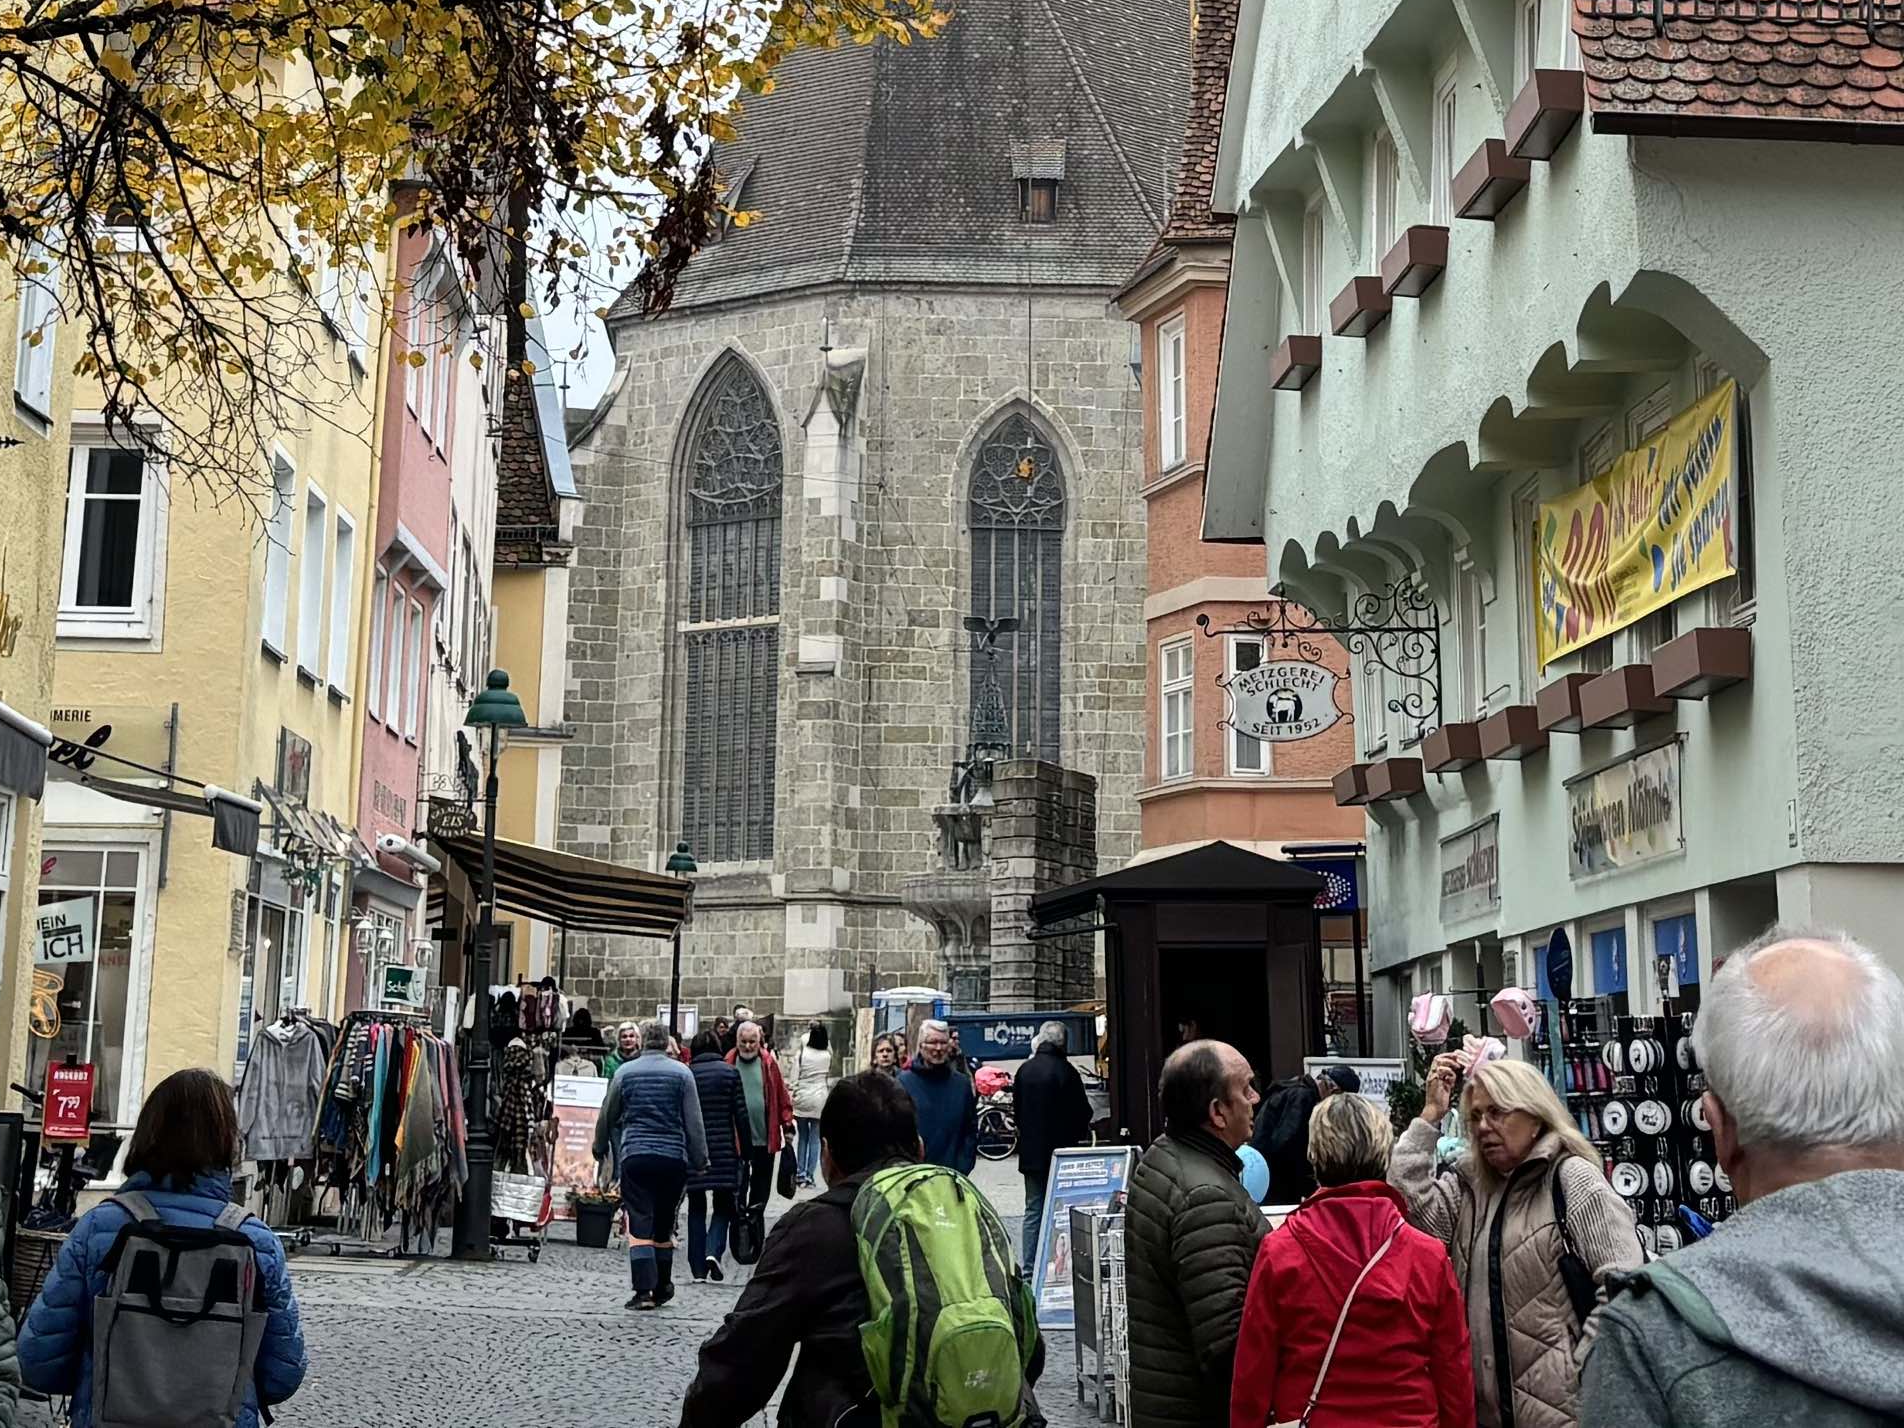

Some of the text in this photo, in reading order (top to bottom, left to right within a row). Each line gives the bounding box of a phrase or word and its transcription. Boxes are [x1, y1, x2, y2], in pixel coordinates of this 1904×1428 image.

[1238, 666, 1326, 692] METZGEREI
[1246, 677, 1321, 697] SCHLECHT
[50, 709, 92, 722] MERIE
[1251, 718, 1322, 736] SEIT 1952
